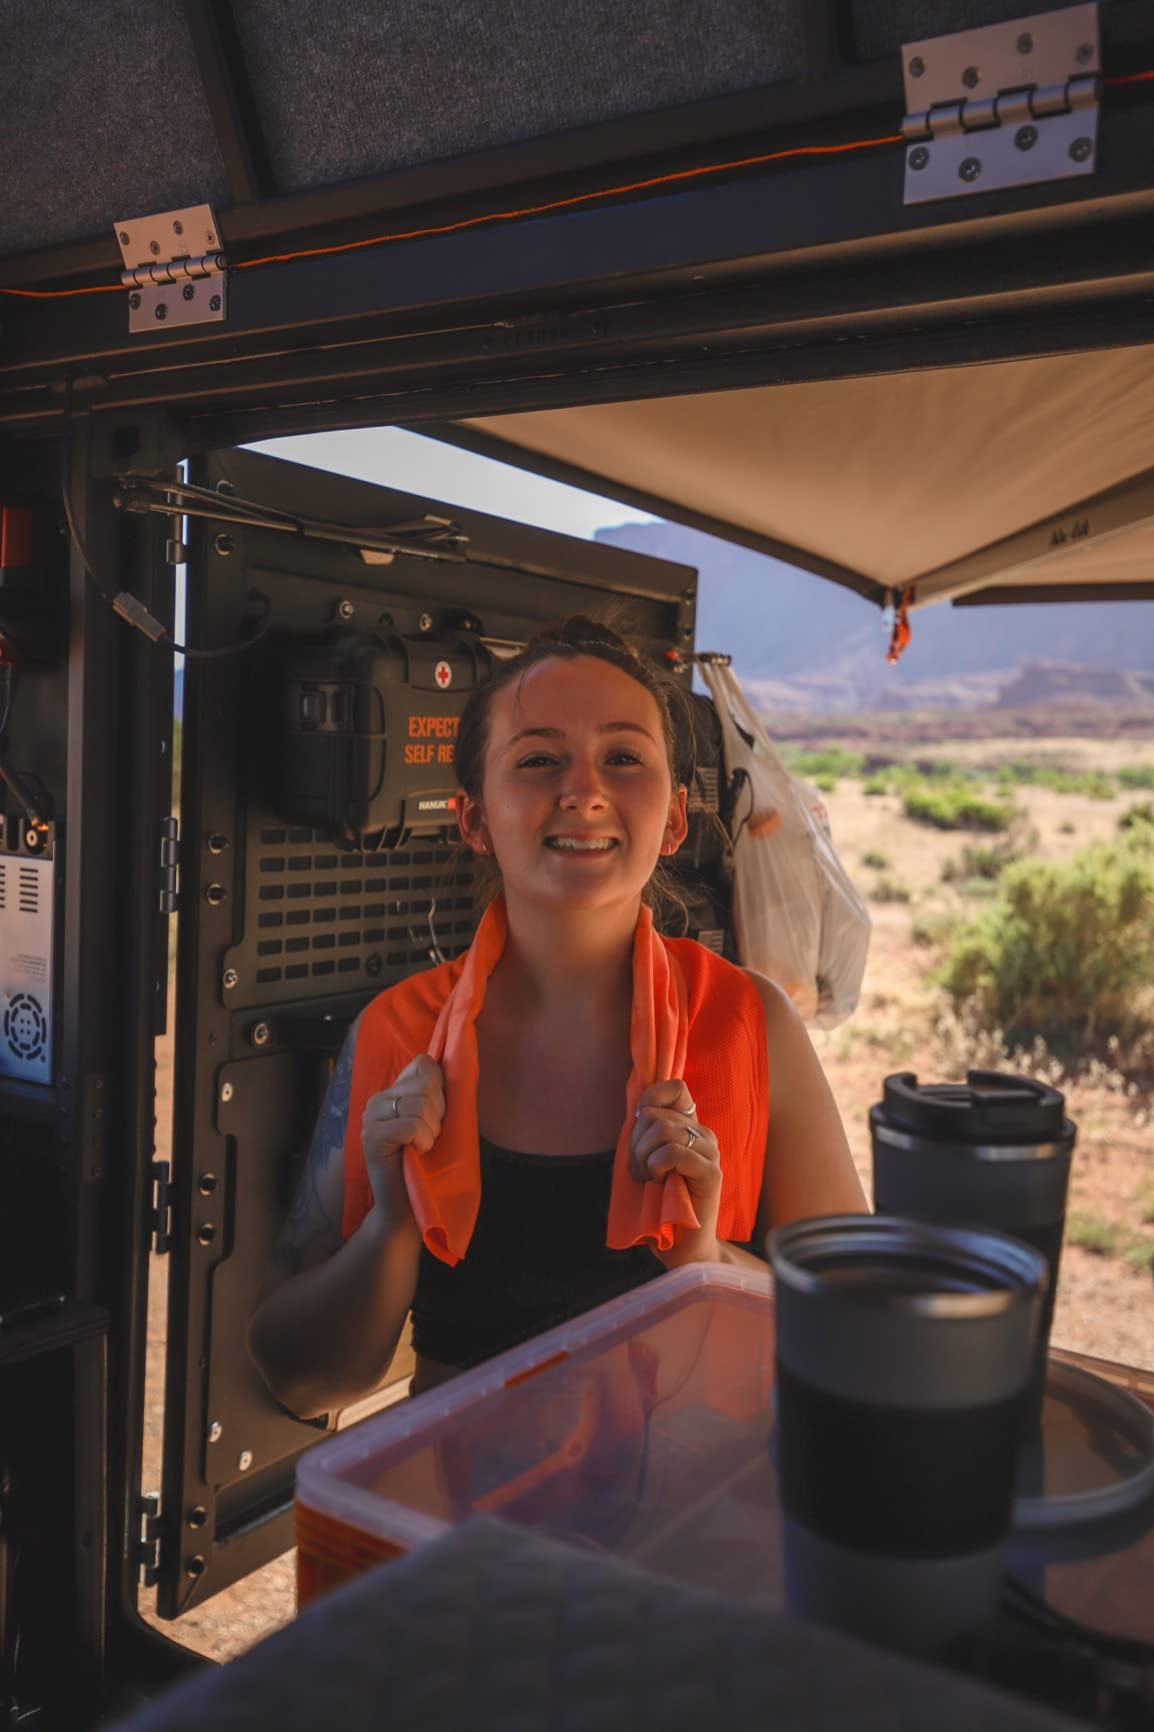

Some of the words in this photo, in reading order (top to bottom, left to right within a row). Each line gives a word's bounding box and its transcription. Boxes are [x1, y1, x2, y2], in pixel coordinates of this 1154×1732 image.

[408, 716, 460, 737] EXPECT
[404, 744, 434, 764] SELF
[438, 744, 454, 763] RE
[418, 800, 447, 810] NANUK
